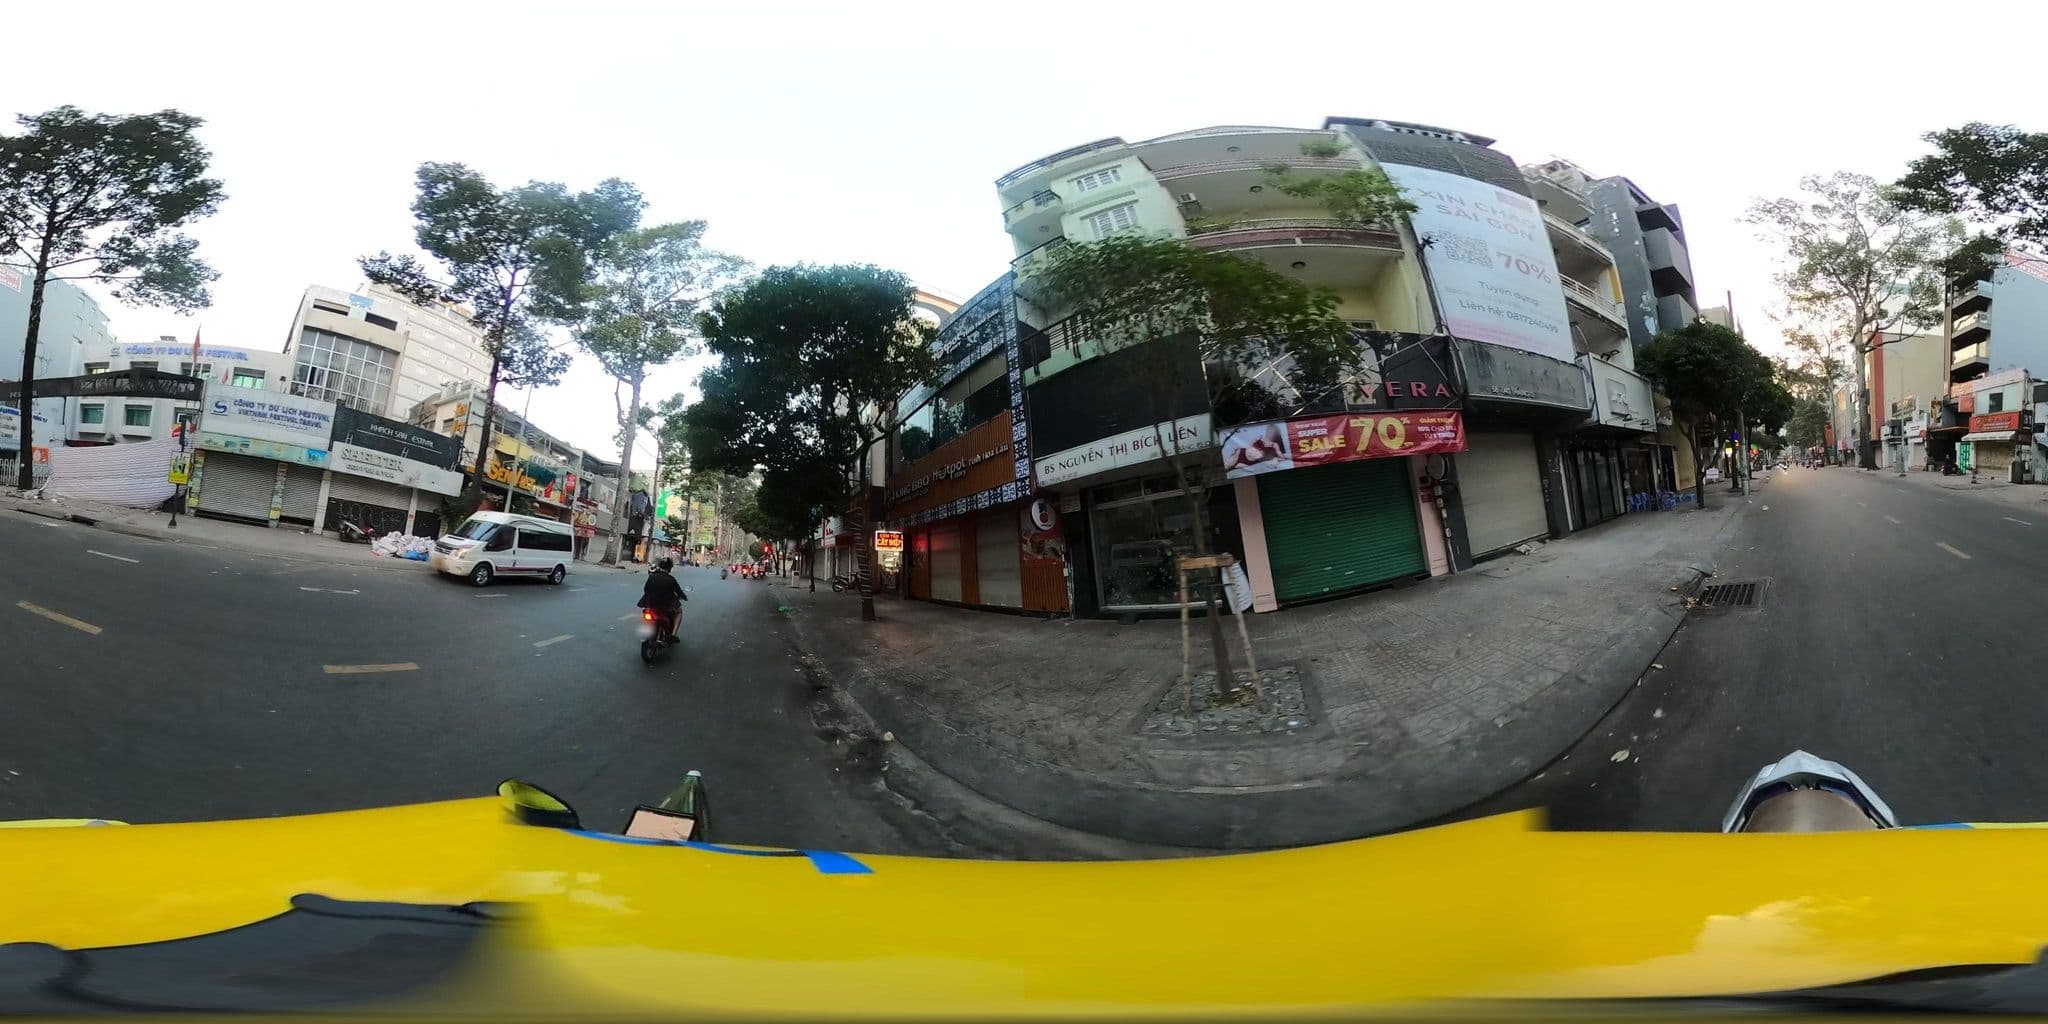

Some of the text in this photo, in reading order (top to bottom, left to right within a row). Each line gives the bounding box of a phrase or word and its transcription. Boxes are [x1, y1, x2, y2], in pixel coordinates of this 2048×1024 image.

[1495, 251, 1552, 284] 70%
[1360, 381, 1450, 398] VERA
[1297, 428, 1329, 438] SUPER
[1298, 434, 1347, 453] SALE
[1043, 462, 1056, 476] BS
[1108, 443, 1129, 458] THỊ
[1132, 432, 1163, 452] BÍCH
[911, 474, 930, 492] BBQ
